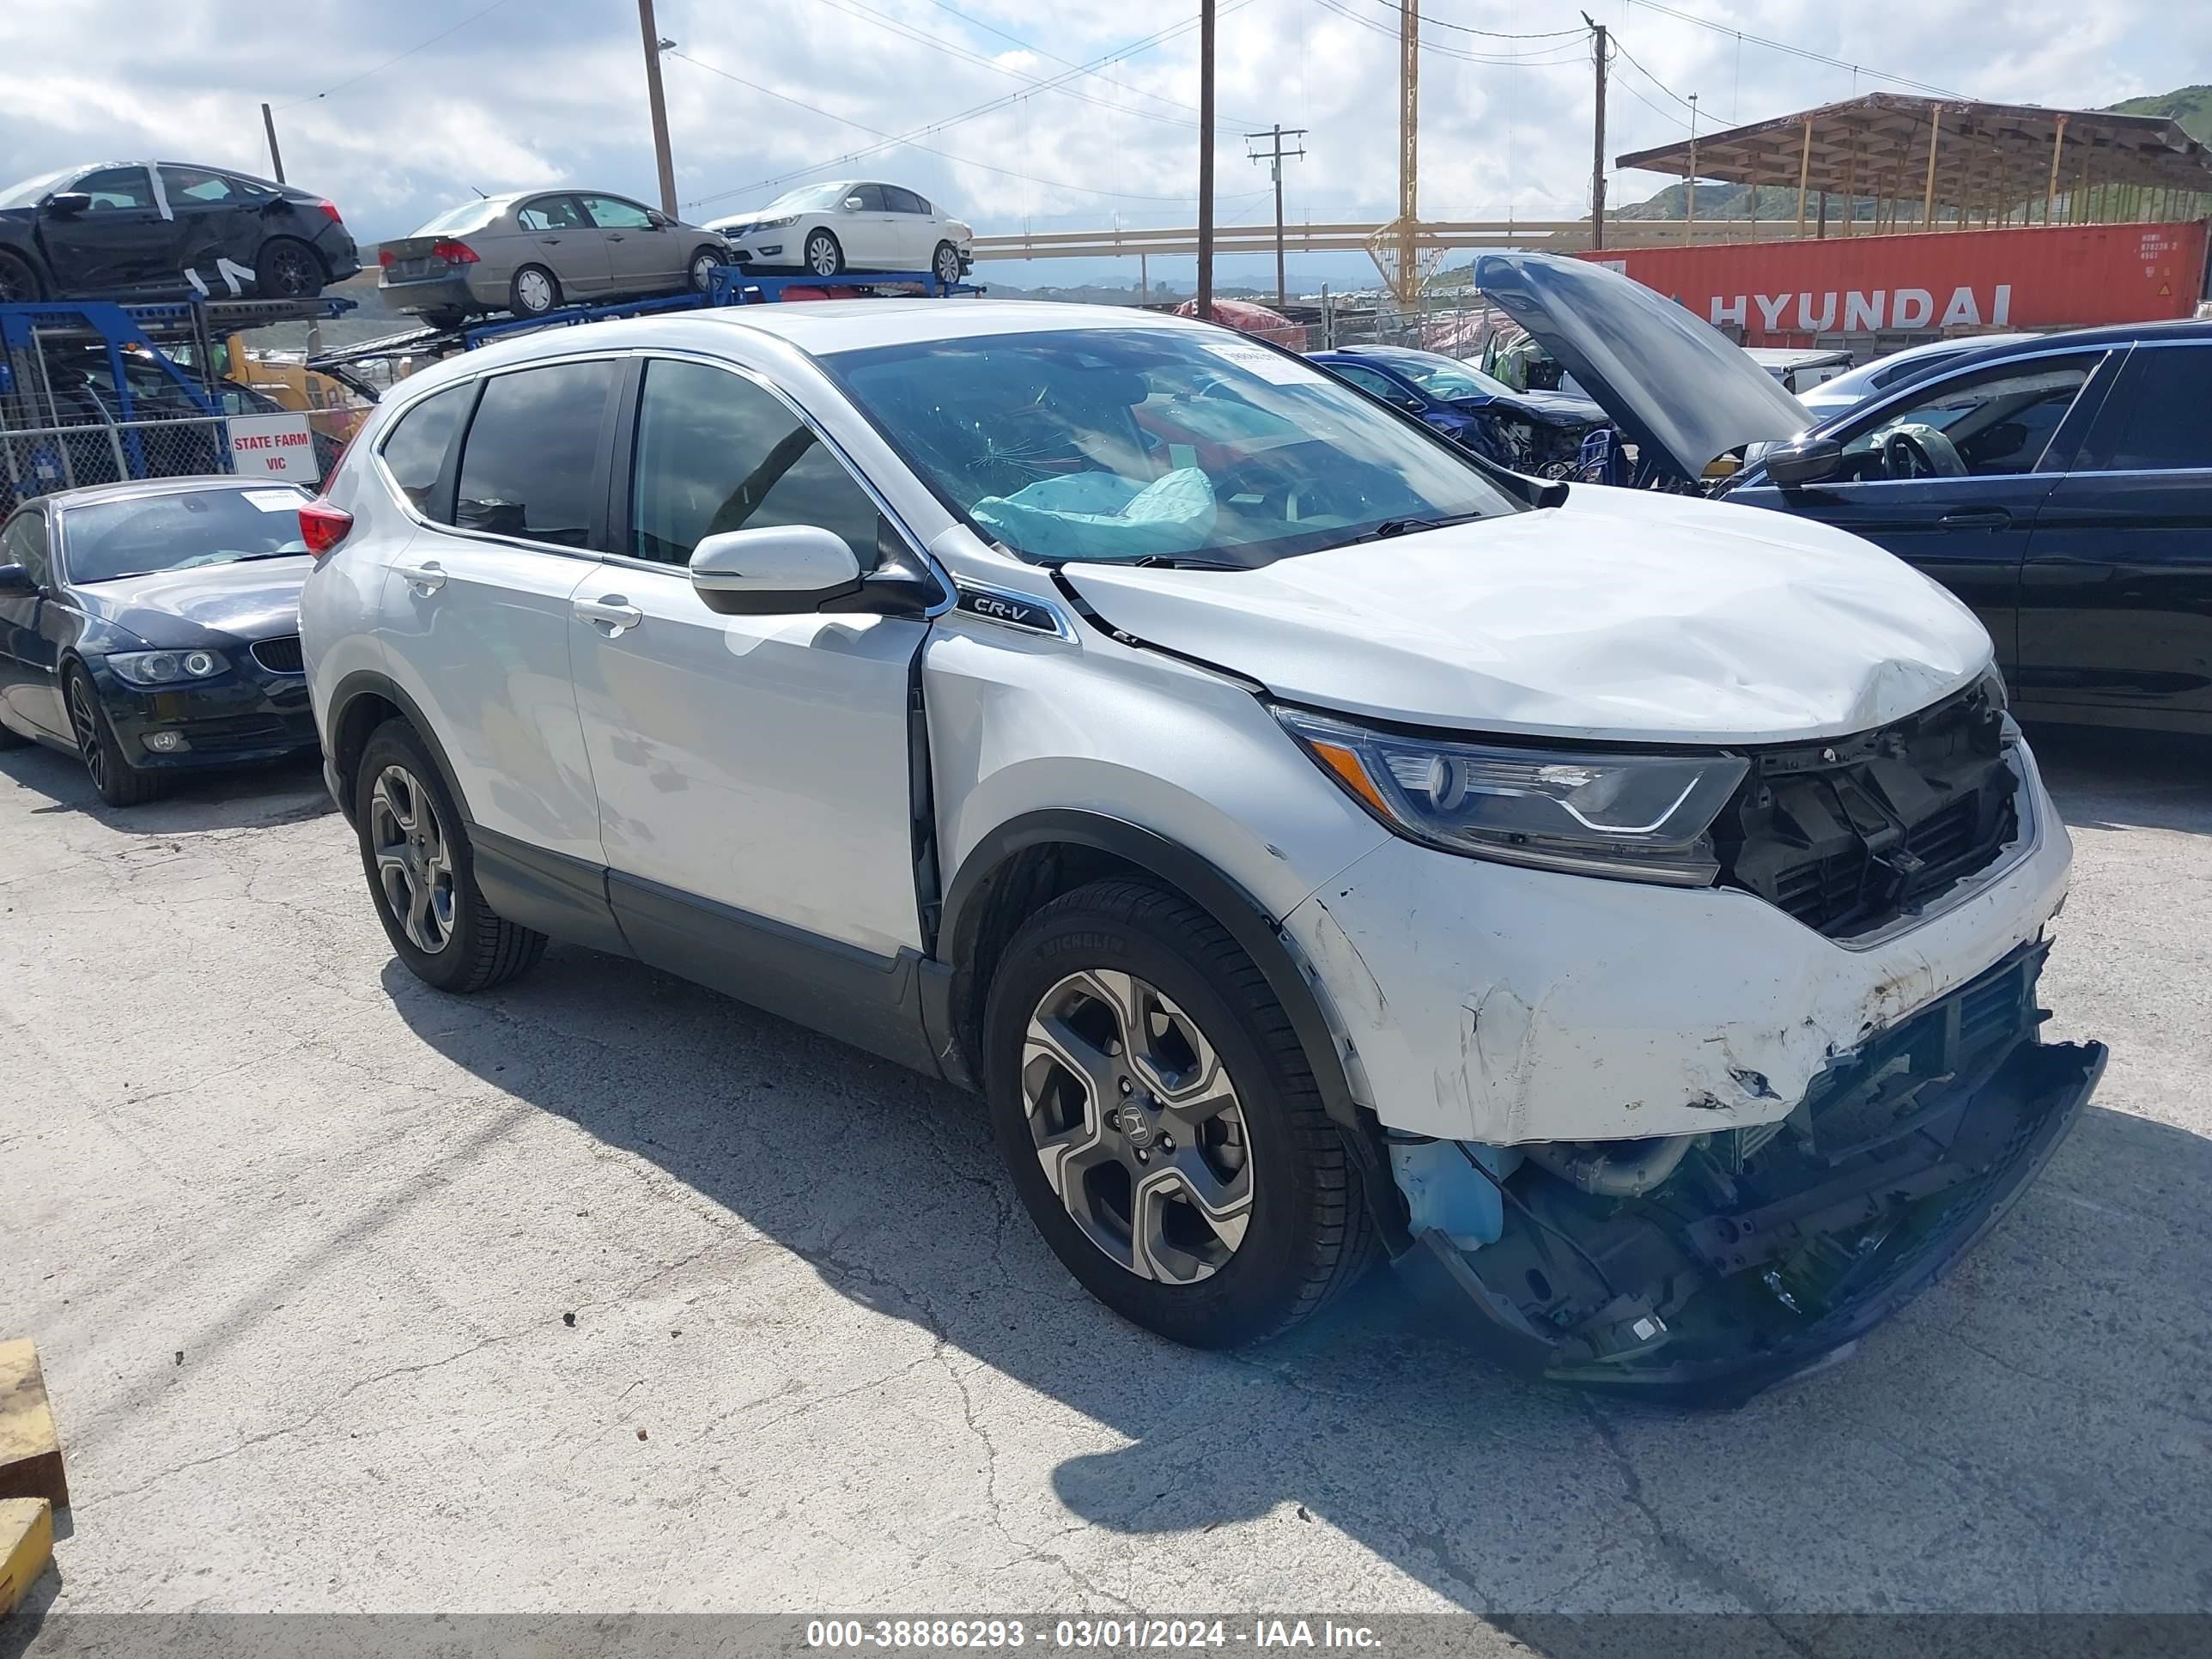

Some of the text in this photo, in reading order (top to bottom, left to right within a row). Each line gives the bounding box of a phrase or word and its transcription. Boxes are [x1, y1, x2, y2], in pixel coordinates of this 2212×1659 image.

[1711, 284, 2012, 331] HYUNDAI
[234, 433, 308, 450] STATE FARM
[266, 457, 287, 471] VIC
[974, 598, 1030, 620] CR-V
